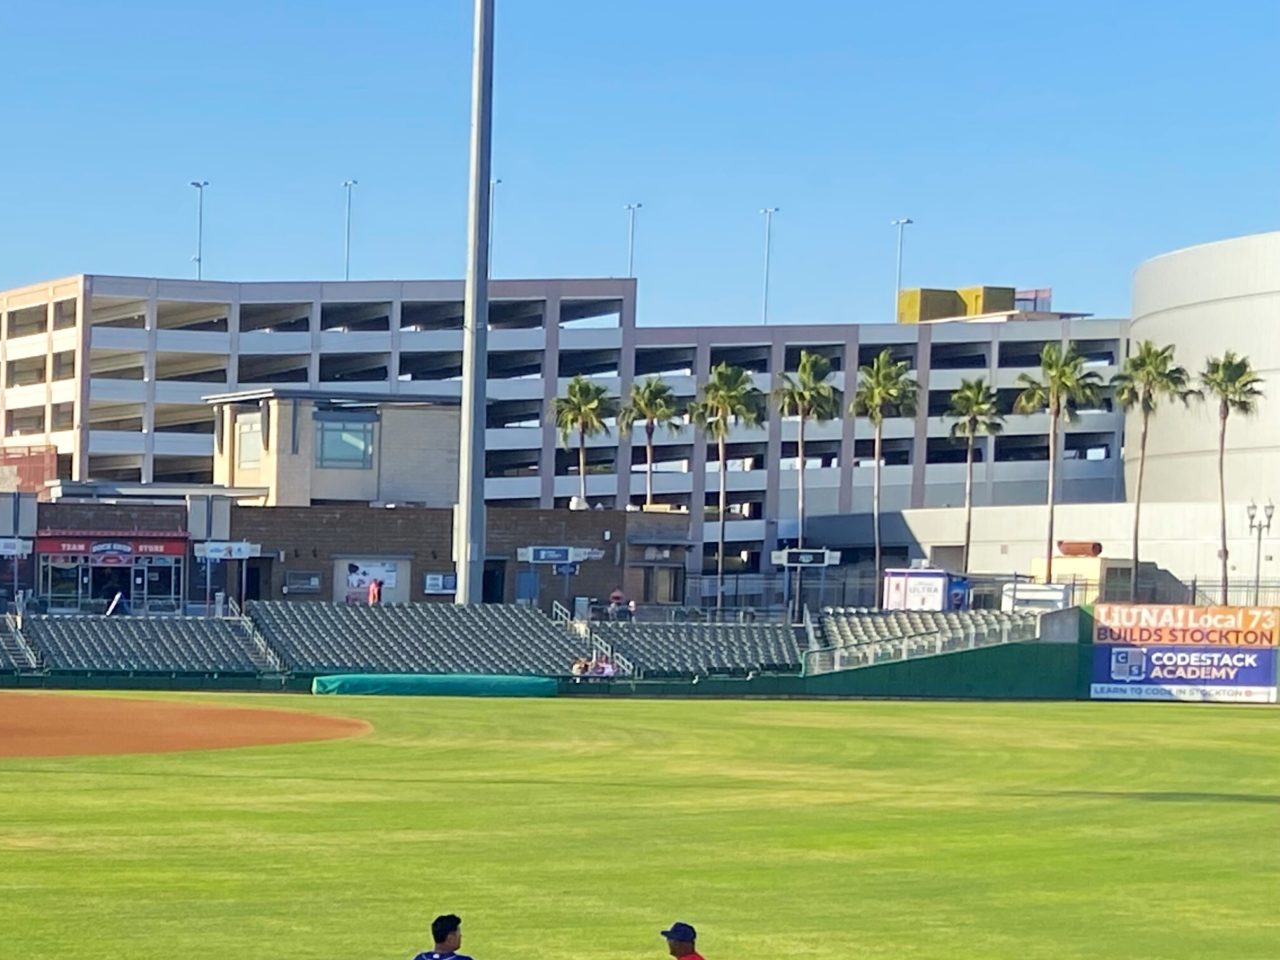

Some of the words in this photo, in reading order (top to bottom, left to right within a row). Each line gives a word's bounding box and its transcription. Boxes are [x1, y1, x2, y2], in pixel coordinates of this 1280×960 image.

[61, 543, 85, 551] TEAM
[138, 544, 164, 552] STORE
[1188, 608, 1243, 628] Local
[1248, 610, 1275, 629] 73
[1097, 628, 1162, 641] BUILDS
[1169, 629, 1273, 644] STOCKTON
[1151, 652, 1258, 668] CODESTACK
[1150, 666, 1238, 679] ACADEMY
[1130, 687, 1143, 695] TO
[1145, 687, 1174, 696] CODE
[1189, 688, 1243, 697] STOCKTON
